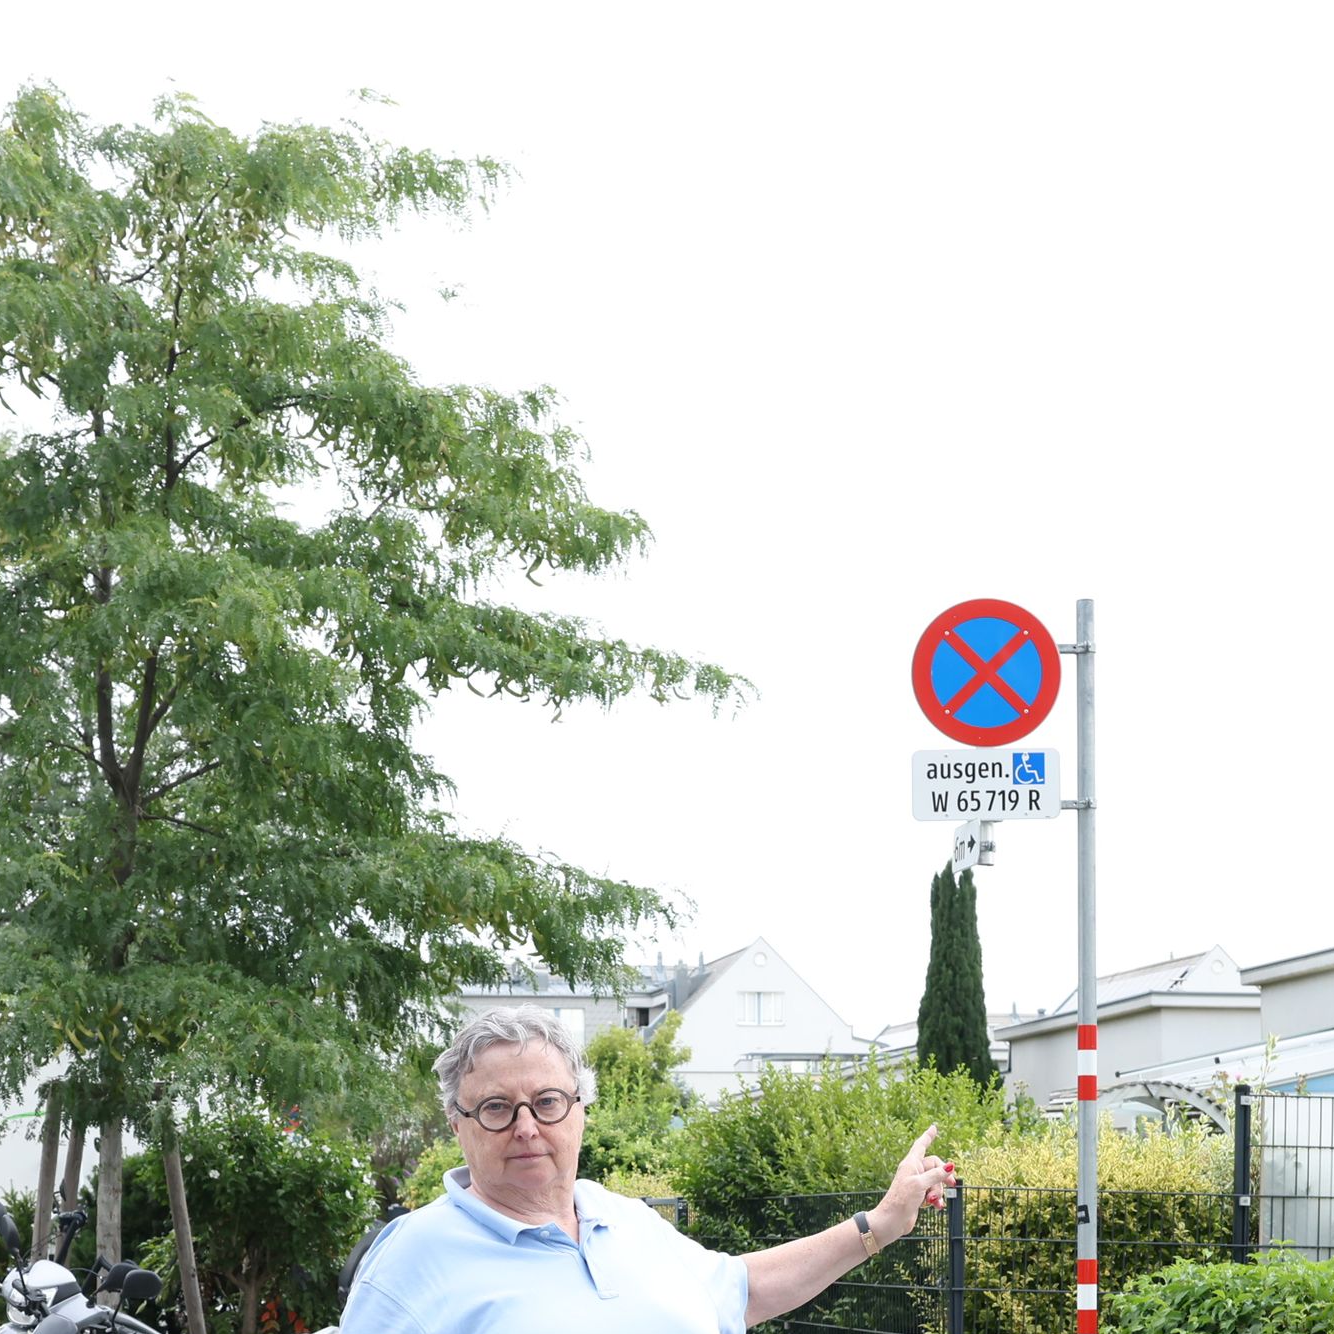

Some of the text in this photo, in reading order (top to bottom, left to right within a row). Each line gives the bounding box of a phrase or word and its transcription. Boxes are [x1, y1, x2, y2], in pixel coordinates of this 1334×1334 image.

[926, 761, 1010, 784] ausgen.
[931, 790, 949, 813] W
[1028, 789, 1041, 811] R
